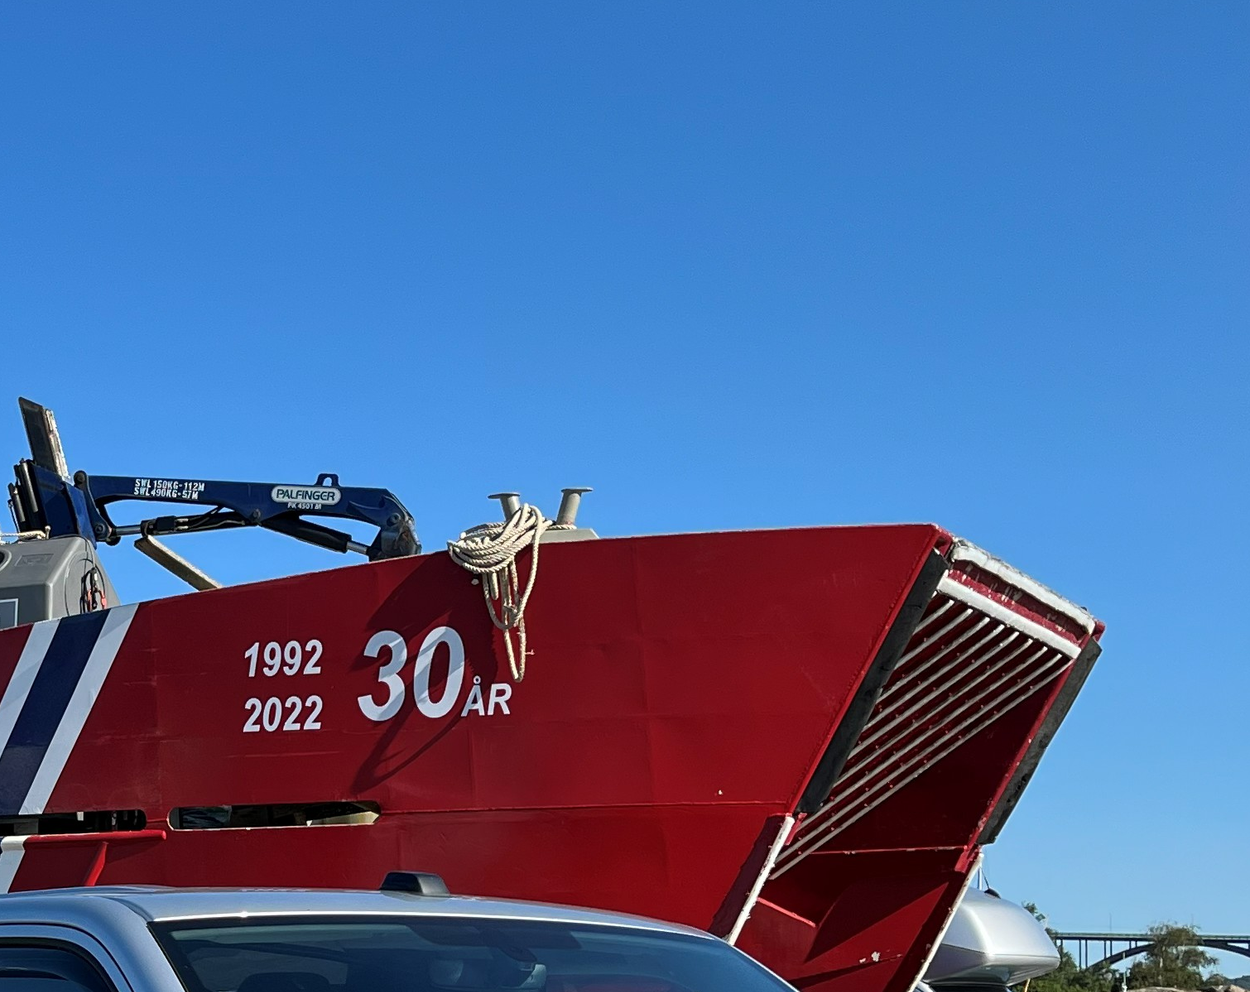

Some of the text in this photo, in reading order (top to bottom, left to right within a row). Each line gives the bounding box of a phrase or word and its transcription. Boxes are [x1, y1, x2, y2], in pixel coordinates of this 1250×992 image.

[134, 487, 150, 496] SWL
[135, 478, 151, 488] SWL
[276, 489, 336, 501] PALFINGER
[244, 639, 323, 678] 1992
[357, 626, 512, 722] 30 ÅR
[243, 695, 323, 733] 2022
